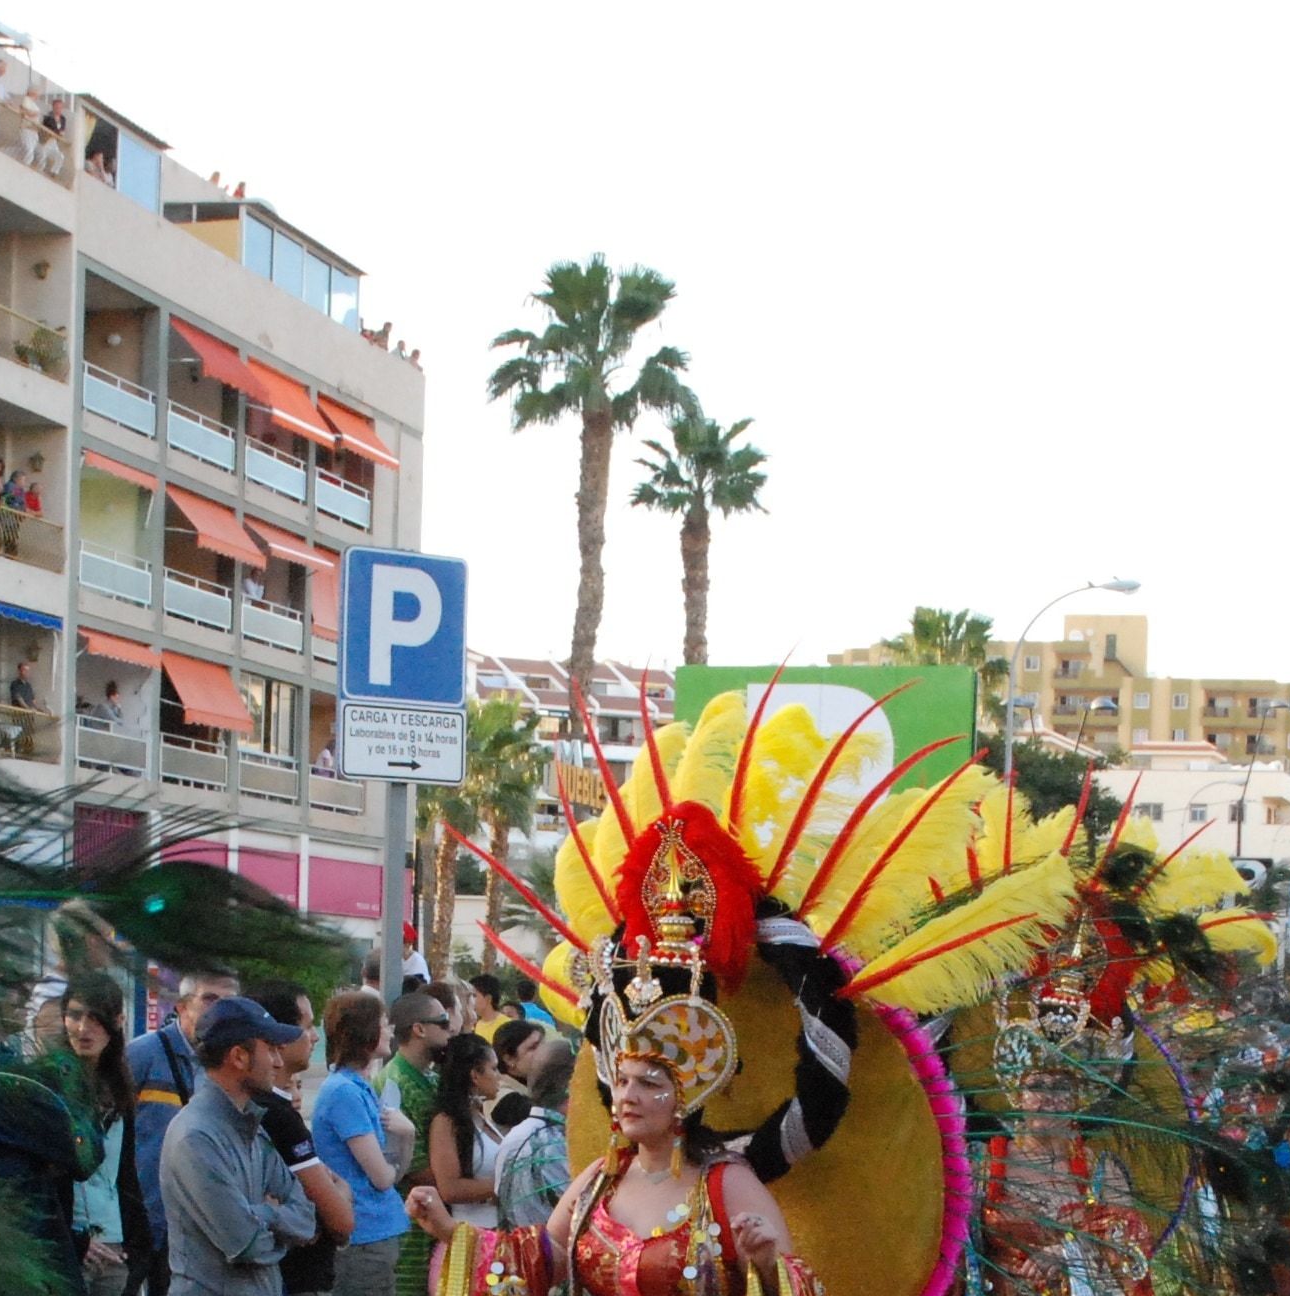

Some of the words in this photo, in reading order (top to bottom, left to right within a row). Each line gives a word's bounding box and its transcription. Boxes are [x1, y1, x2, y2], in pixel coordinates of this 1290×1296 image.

[369, 563, 442, 686] P
[350, 710, 388, 723] CARGA
[391, 713, 398, 724] Y
[349, 727, 396, 740] Laborables
[397, 731, 408, 741] de
[410, 730, 416, 743] 9
[417, 734, 422, 742] a
[425, 731, 434, 743] 14
[435, 732, 458, 745] horas
[367, 747, 373, 756] y
[375, 745, 385, 754] de
[407, 745, 417, 758] 19
[418, 747, 441, 758] horas
